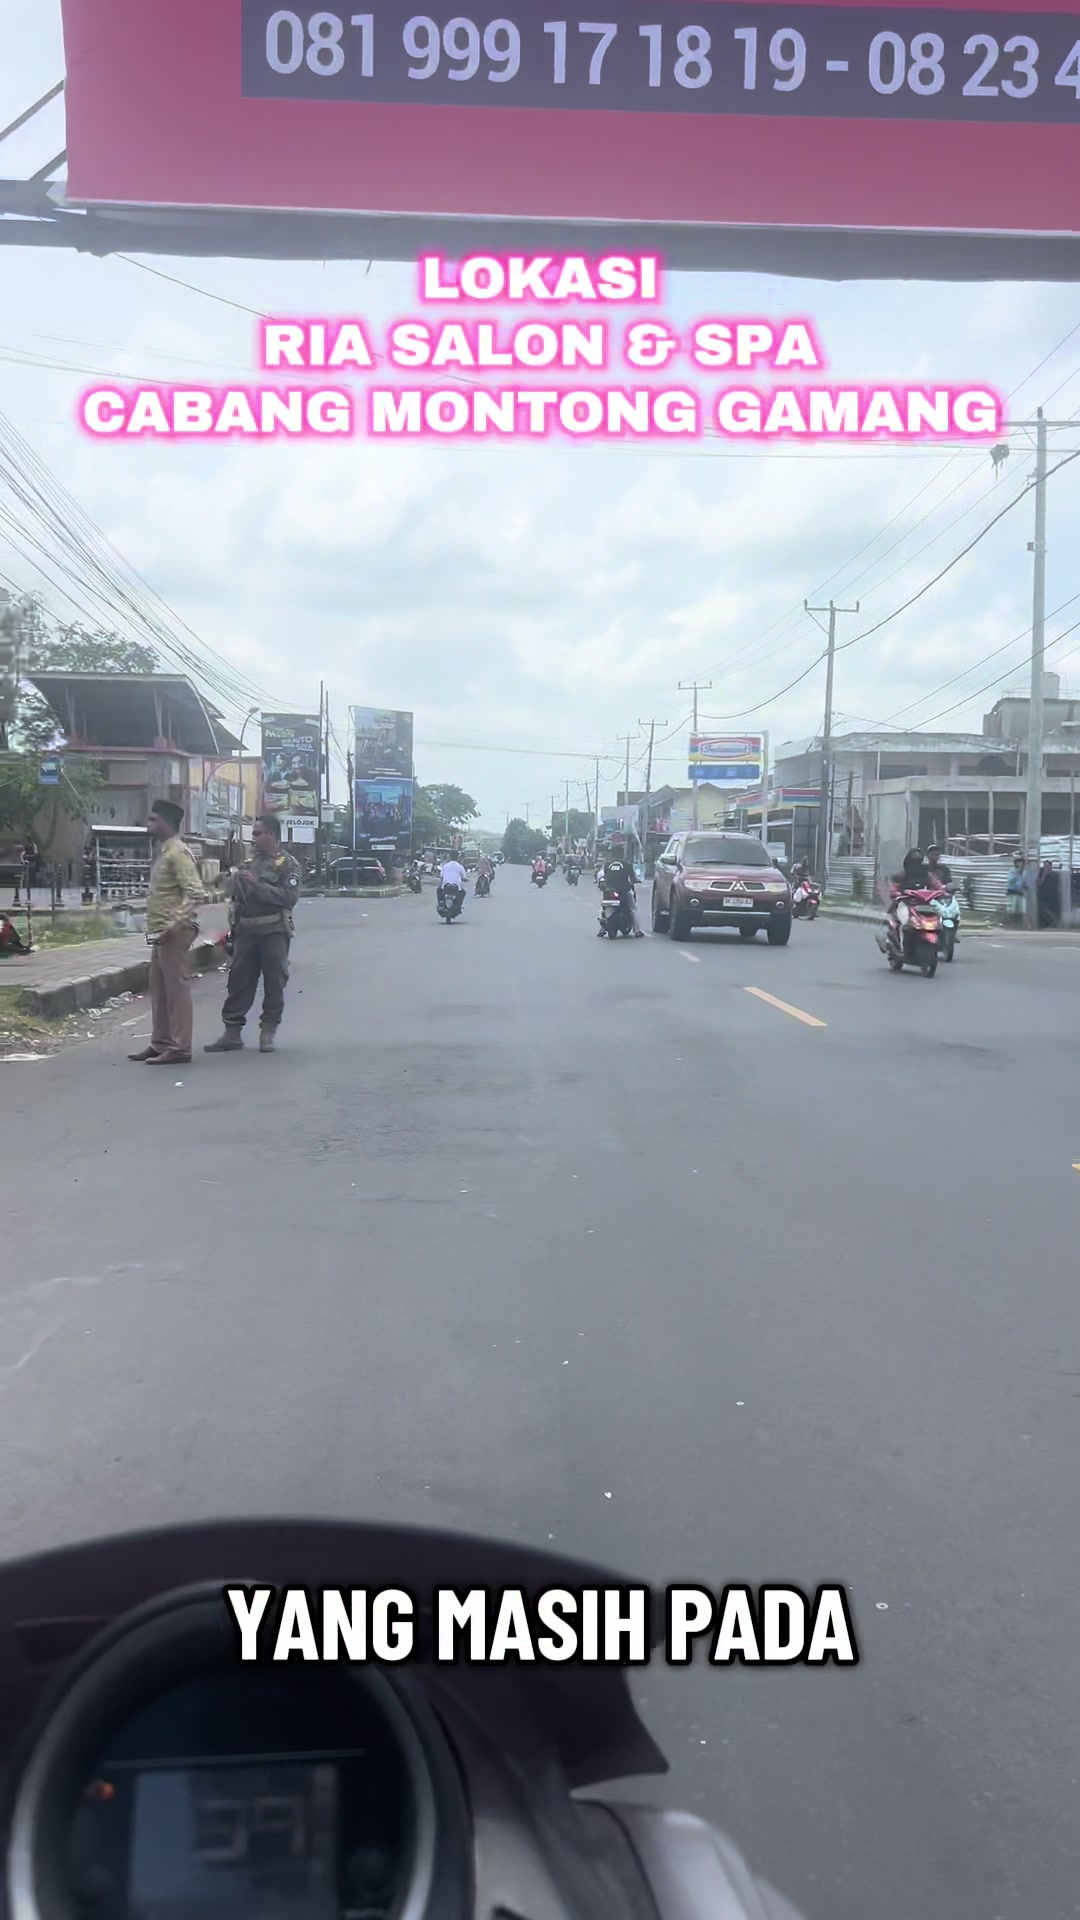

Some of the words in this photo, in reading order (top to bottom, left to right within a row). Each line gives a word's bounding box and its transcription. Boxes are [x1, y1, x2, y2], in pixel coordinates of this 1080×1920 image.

[266, 10, 374, 77] 081
[403, 15, 521, 83] 999
[544, 21, 617, 85] 17
[640, 24, 713, 88] 18
[734, 28, 808, 92] 19
[868, 32, 945, 95] 08
[962, 33, 1039, 98] 23
